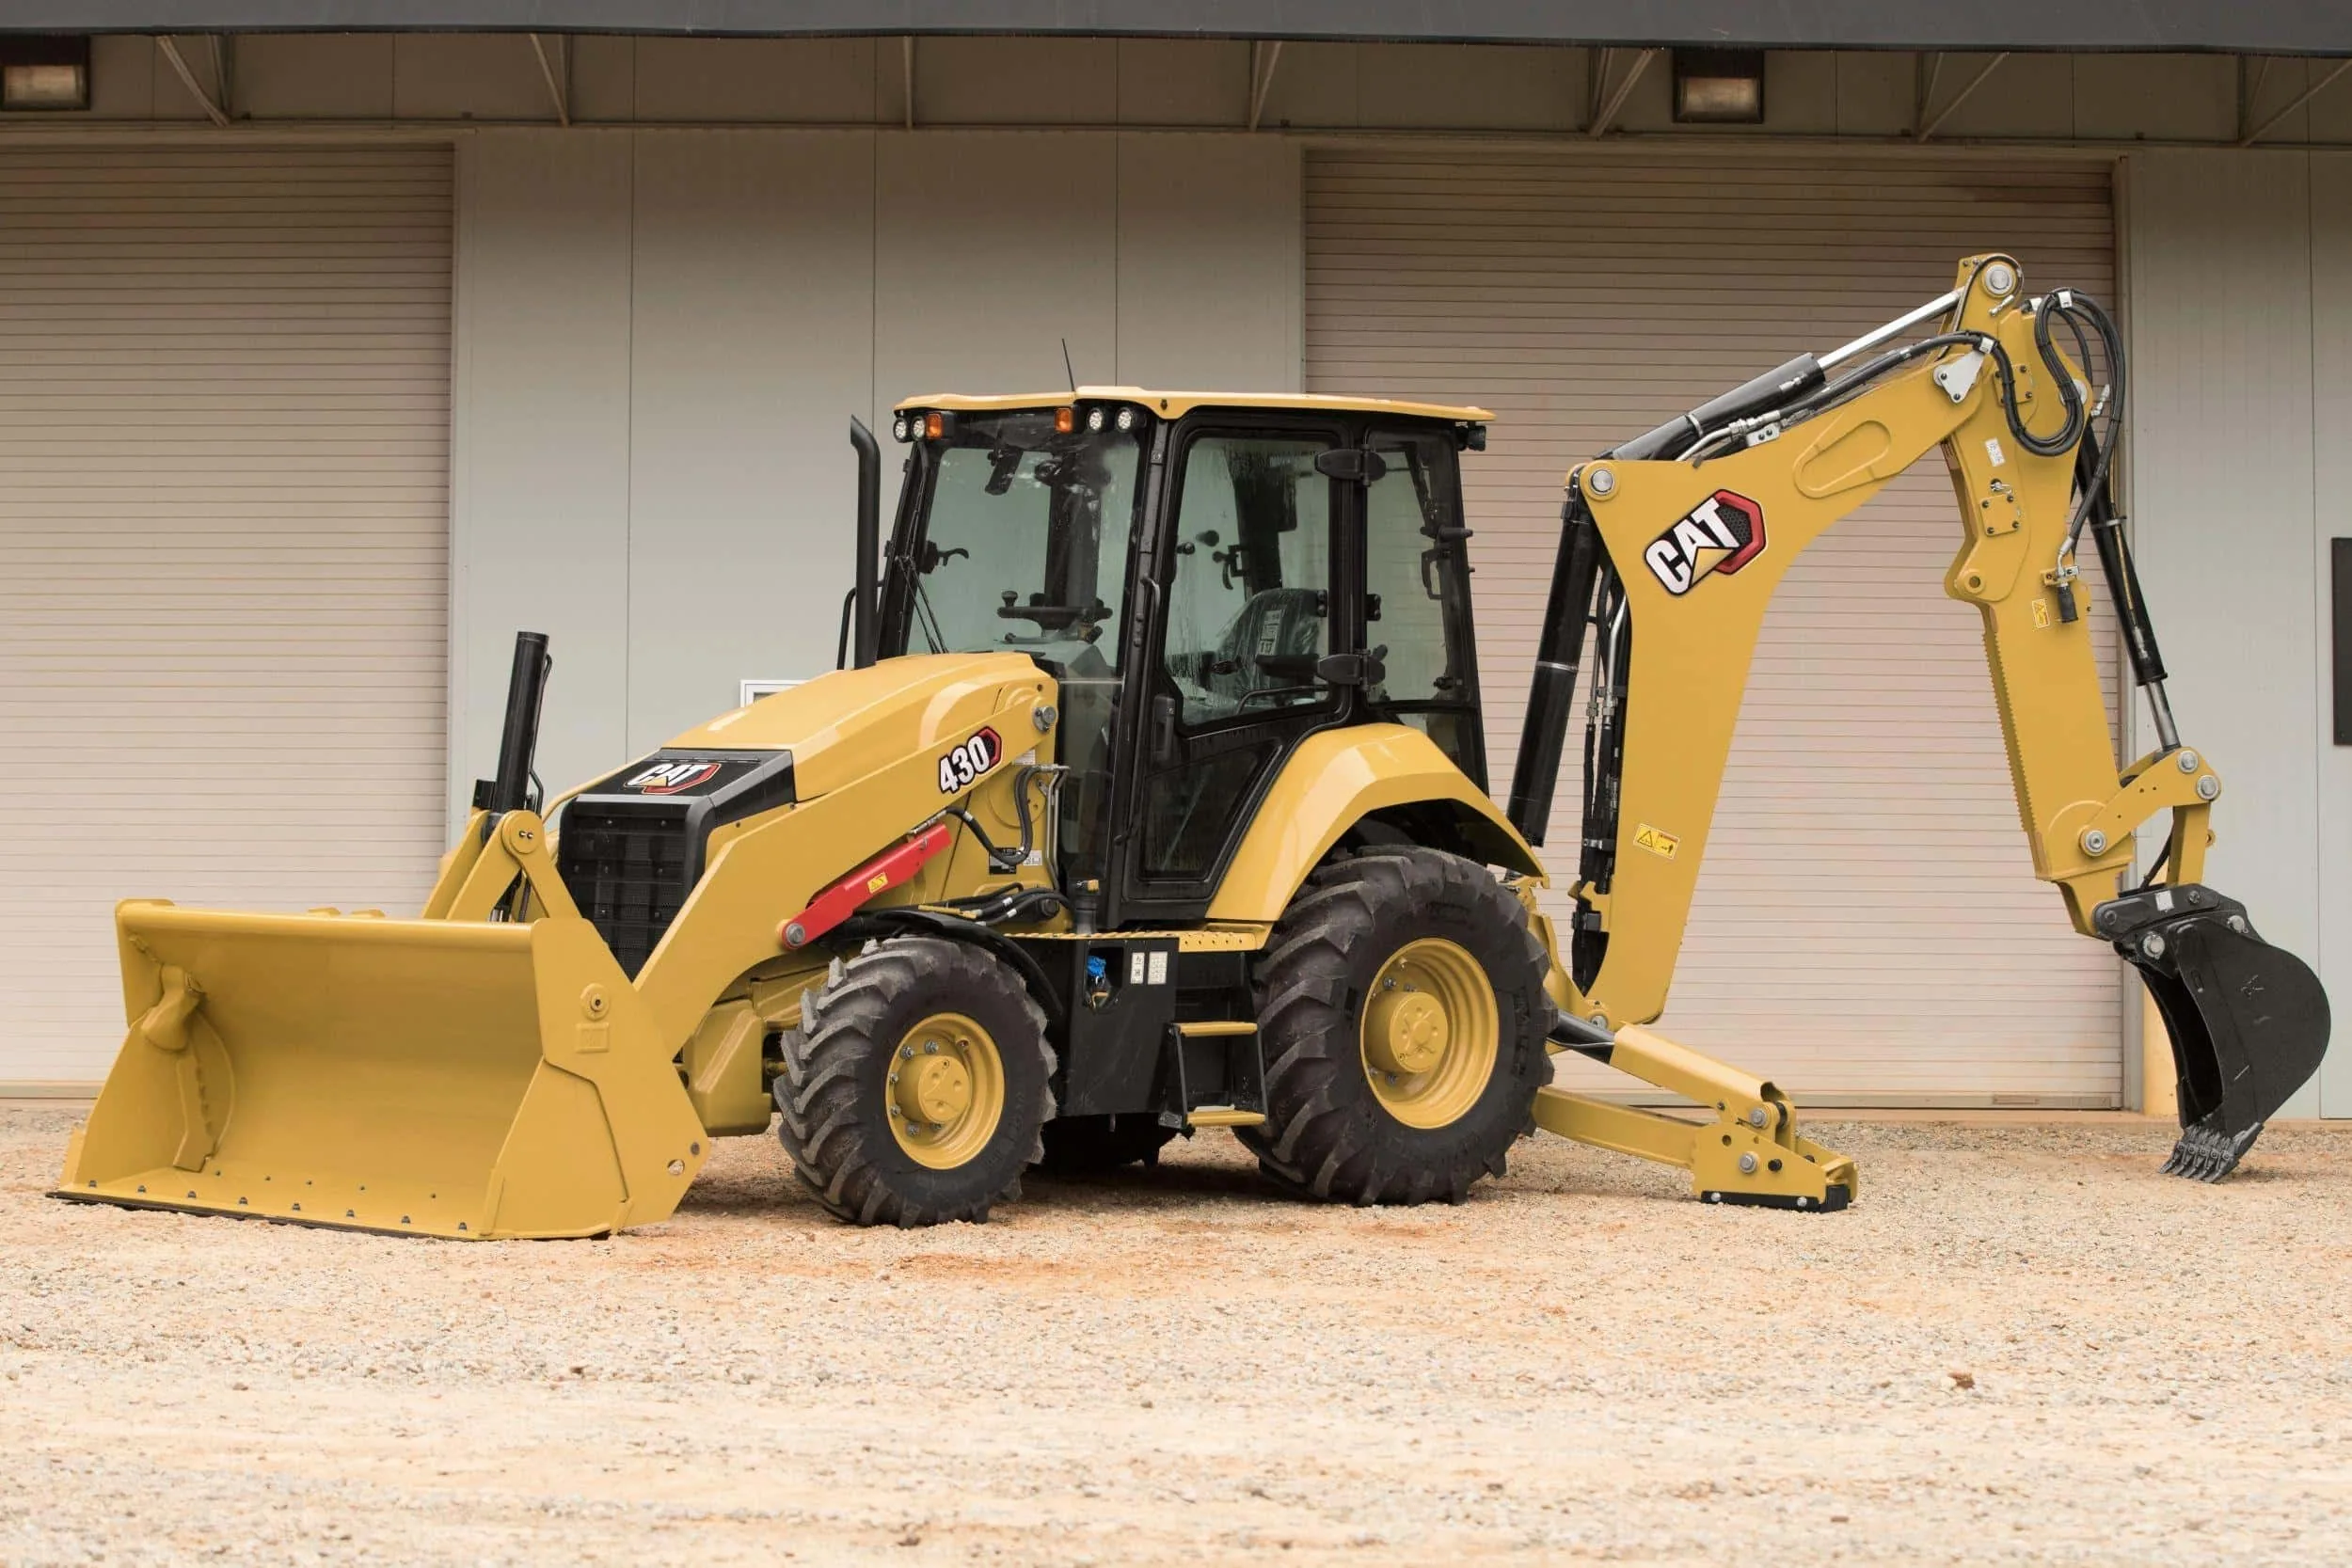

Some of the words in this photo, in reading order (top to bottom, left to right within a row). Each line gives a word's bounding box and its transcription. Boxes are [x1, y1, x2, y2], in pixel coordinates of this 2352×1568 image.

[1645, 497, 1740, 594] CAT
[627, 763, 713, 786] CAT
[940, 736, 990, 791] 430
